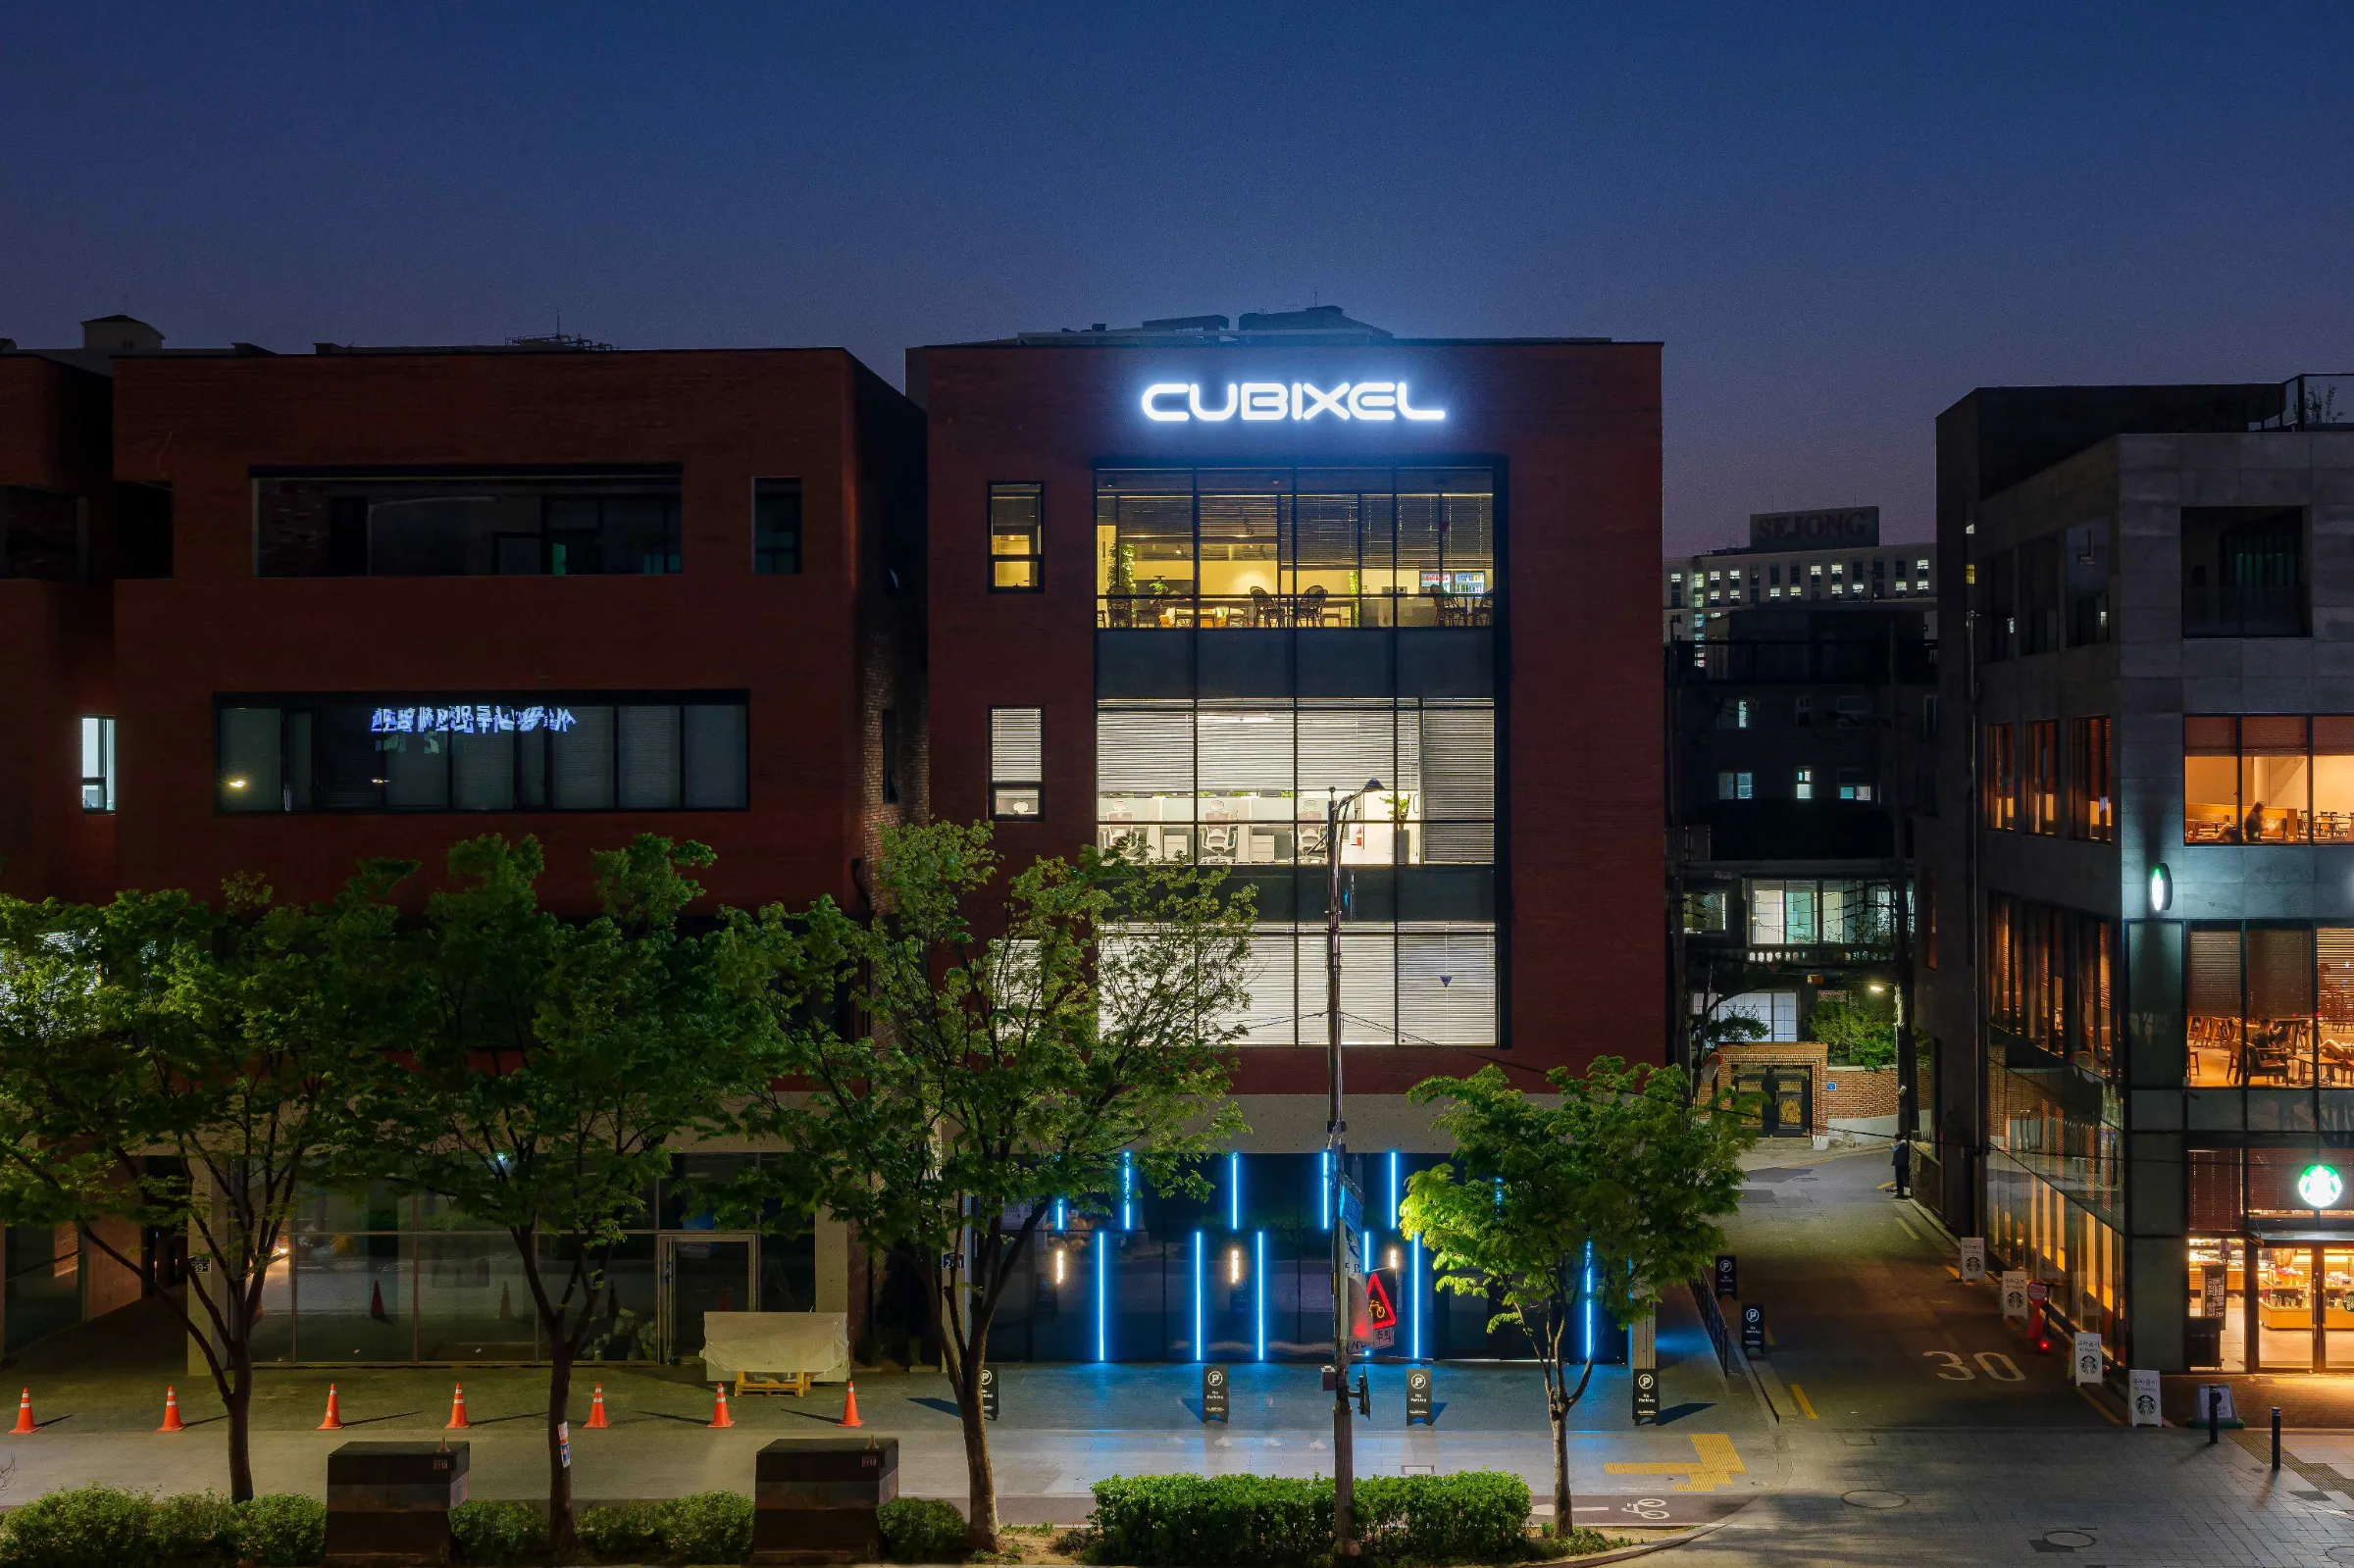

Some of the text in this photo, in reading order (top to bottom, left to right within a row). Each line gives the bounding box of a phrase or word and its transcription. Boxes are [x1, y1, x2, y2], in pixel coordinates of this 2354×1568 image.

[1142, 382, 1446, 421] CUBIXEL
[1757, 512, 1868, 540] SEJONG
[1922, 1350, 2026, 1382] 30
